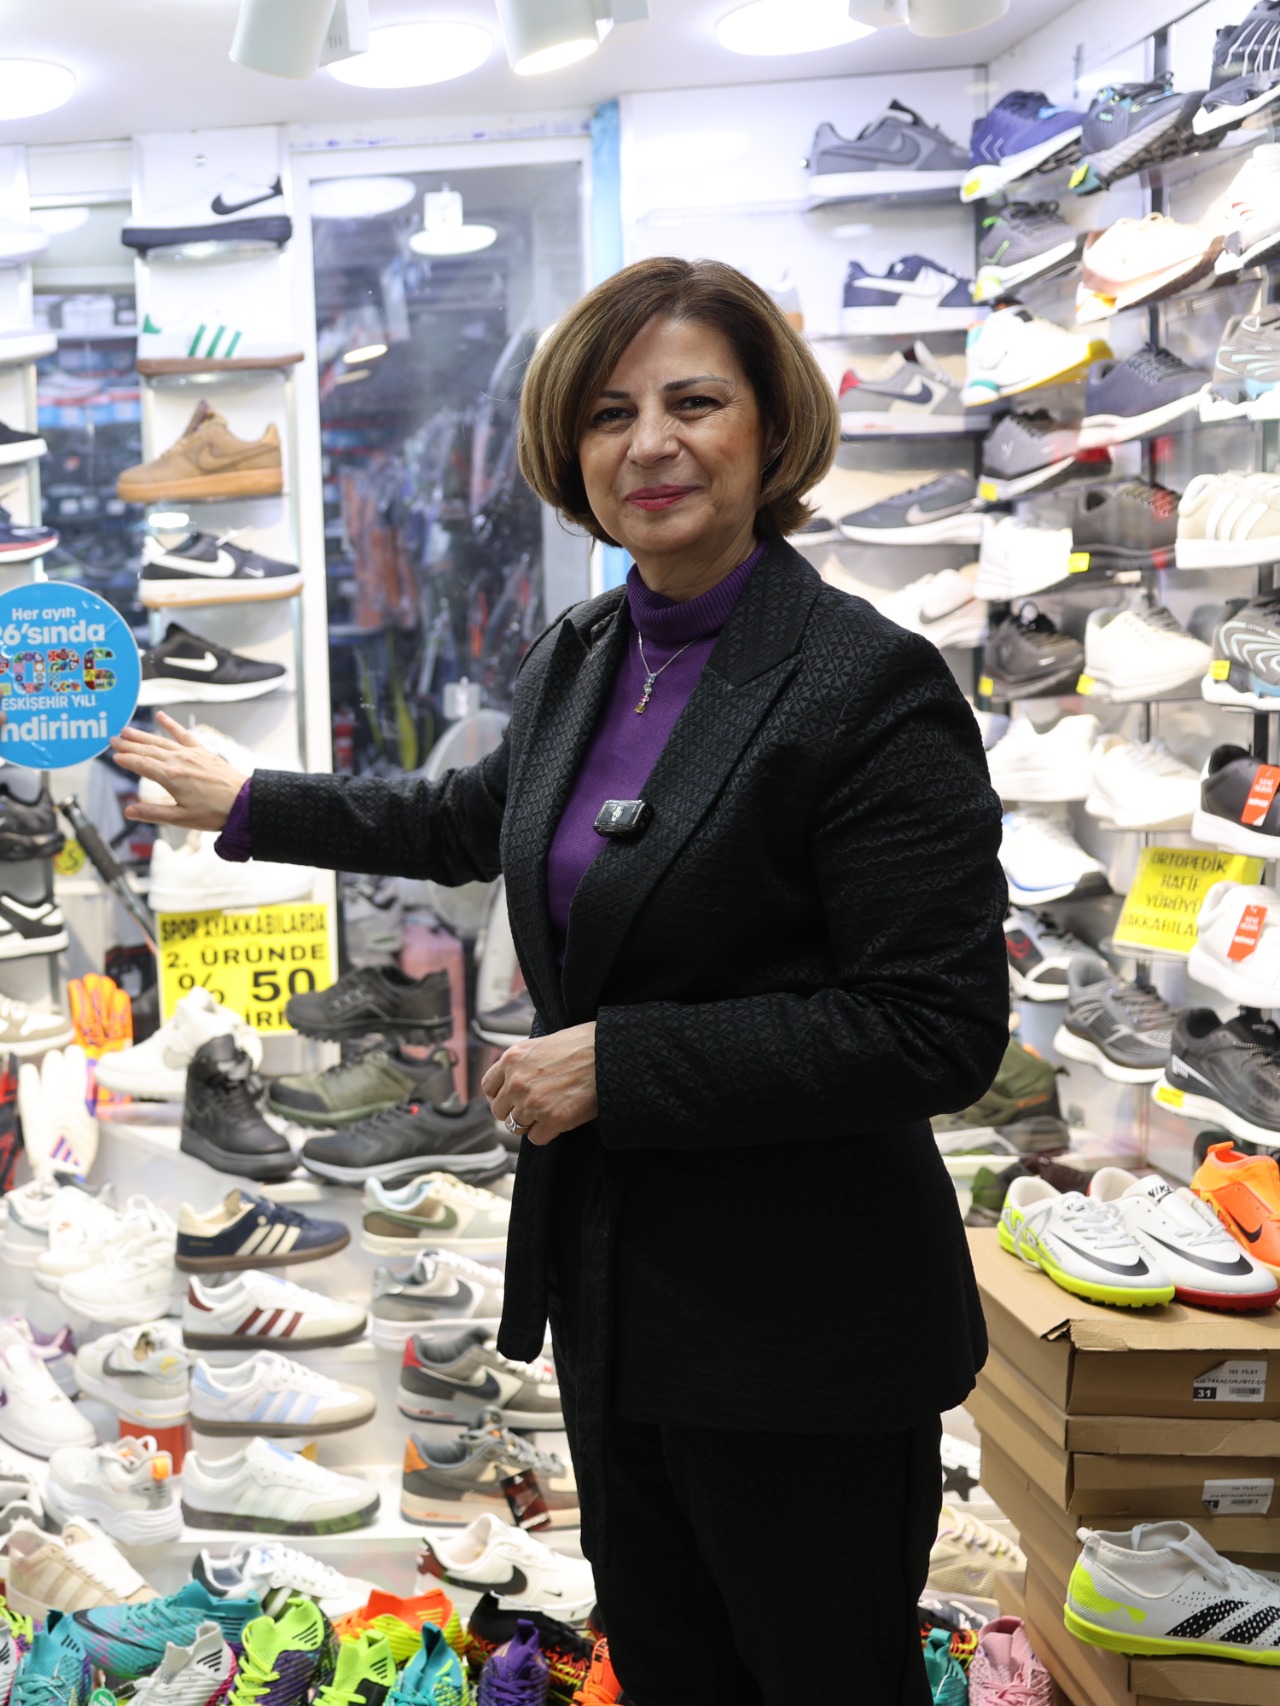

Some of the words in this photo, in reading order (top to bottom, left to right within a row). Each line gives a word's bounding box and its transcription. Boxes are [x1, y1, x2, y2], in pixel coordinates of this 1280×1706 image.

[11, 608, 39, 621] Her
[42, 606, 76, 622] ayın
[1, 694, 69, 712] ESKİŞEHİR
[71, 693, 96, 708] YILI
[1151, 850, 1230, 874] ORTOPEDİK
[1162, 873, 1202, 892] HAFİF
[161, 915, 199, 942] SPOR
[166, 951, 189, 968] 2.
[201, 943, 325, 966] ÜRÜNDE
[252, 968, 316, 1002] 50
